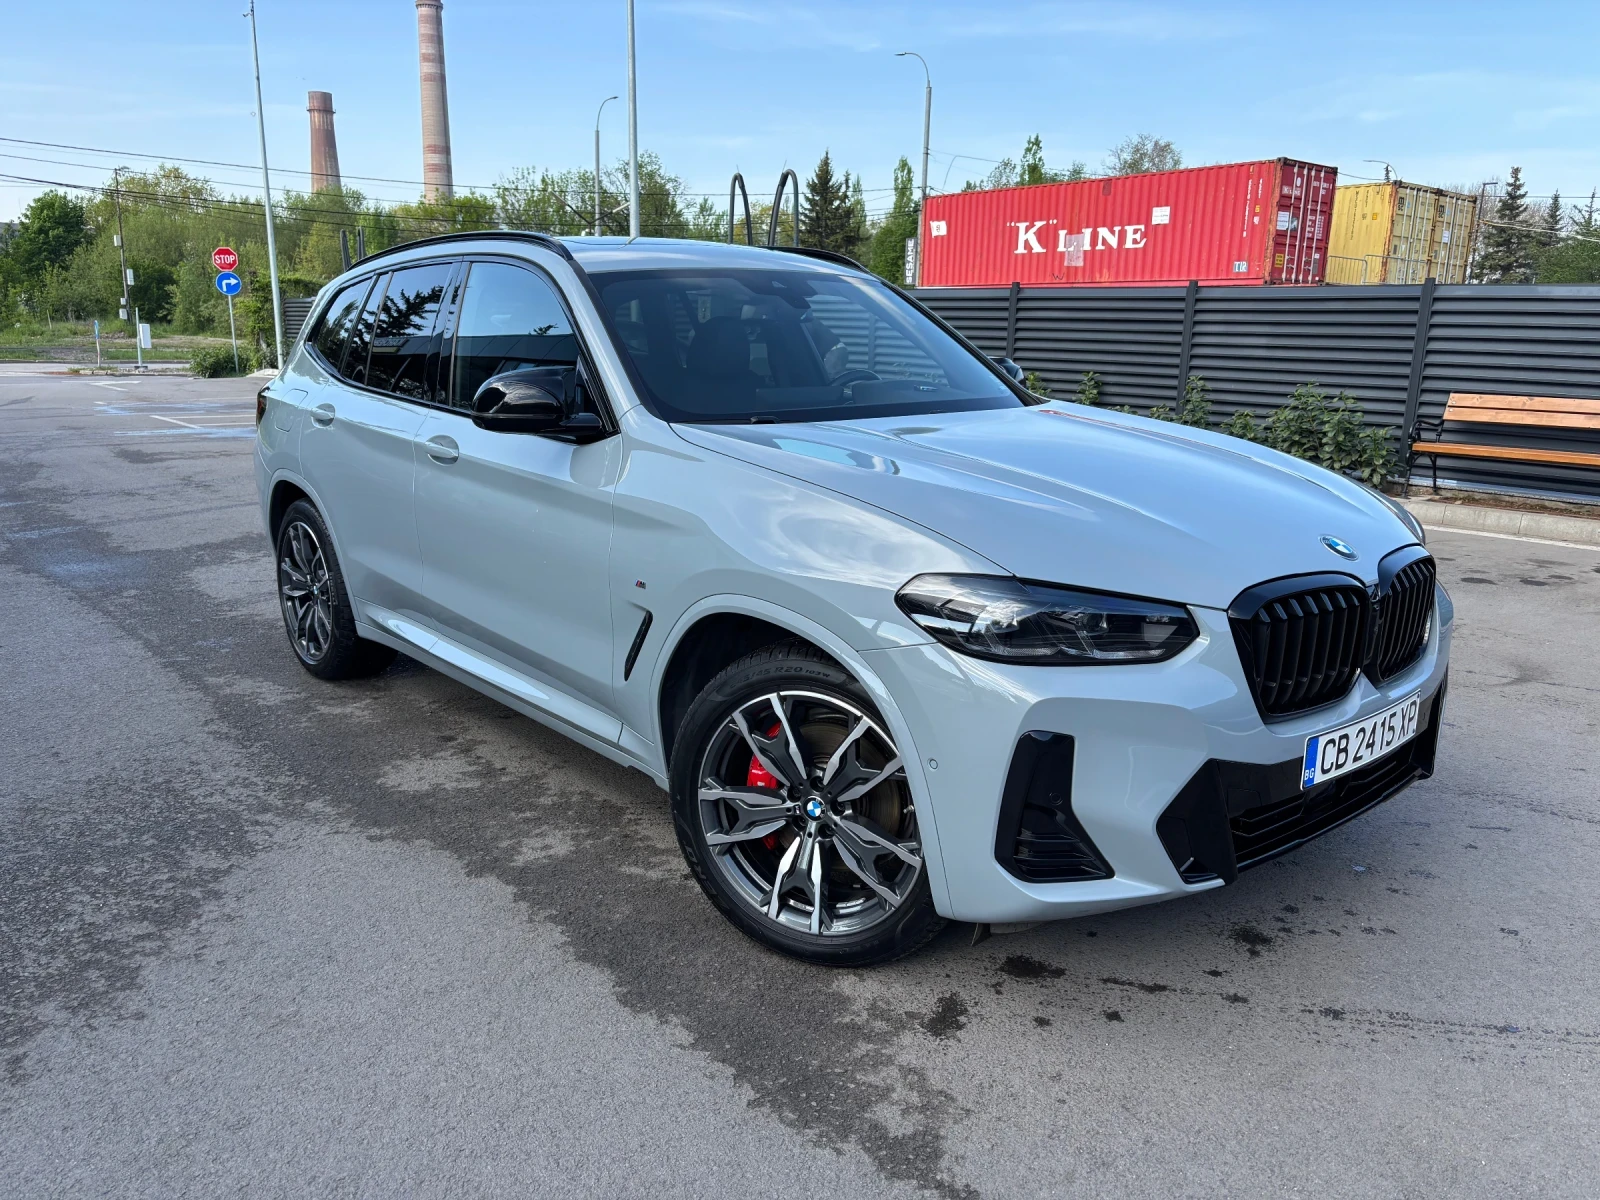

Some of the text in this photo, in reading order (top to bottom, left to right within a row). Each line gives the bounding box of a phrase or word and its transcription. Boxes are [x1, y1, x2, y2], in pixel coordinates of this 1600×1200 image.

[1057, 224, 1147, 252] LINE
[215, 254, 236, 264] STOP
[905, 239, 915, 283] SESAME
[774, 665, 803, 674] R20
[804, 669, 831, 679] 103W
[1321, 700, 1418, 775] CB 2415 XP
[1304, 768, 1315, 780] BG
